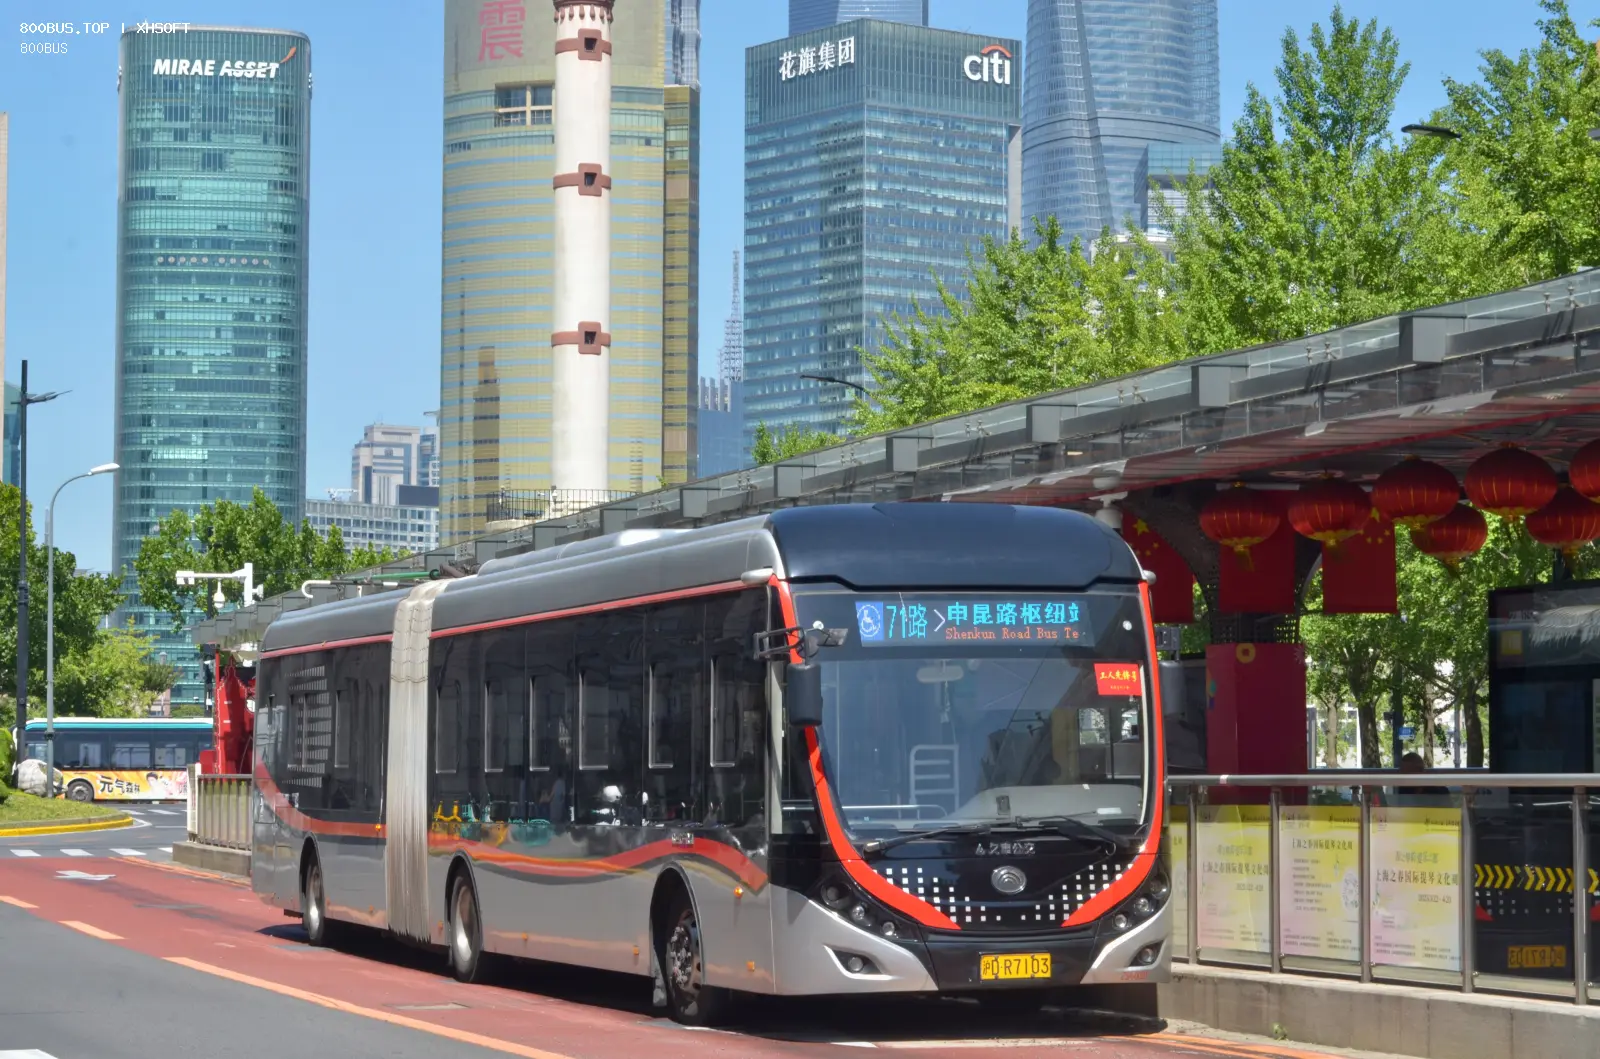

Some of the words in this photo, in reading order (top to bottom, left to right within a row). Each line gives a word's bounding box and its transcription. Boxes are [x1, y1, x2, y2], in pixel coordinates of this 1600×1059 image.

[478, 0, 526, 62] 震
[153, 58, 215, 76] MIRAE
[219, 60, 280, 79] ASSET
[779, 35, 855, 81] 花旗集团
[963, 48, 1011, 85] citi
[885, 603, 928, 639] 71路
[945, 628, 996, 640] Shenkun
[1002, 628, 1031, 640] Road
[1036, 628, 1058, 640] Bus
[1064, 629, 1079, 640] Te
[99, 775, 140, 795] 元气森林
